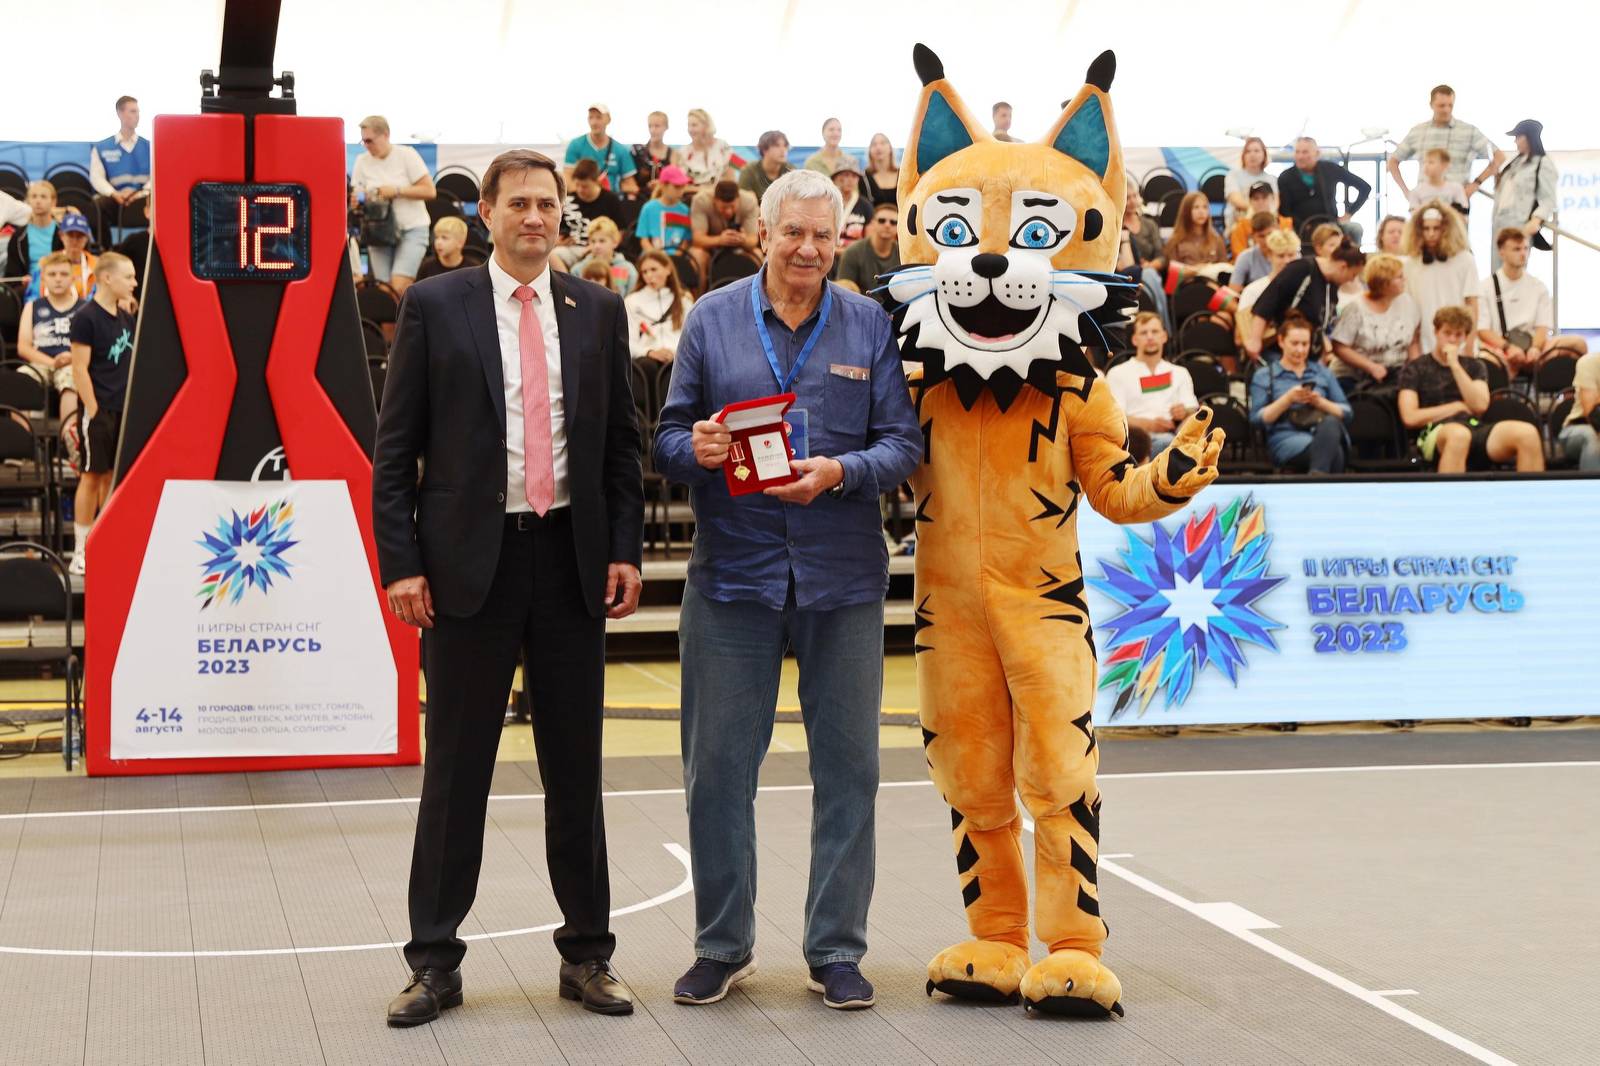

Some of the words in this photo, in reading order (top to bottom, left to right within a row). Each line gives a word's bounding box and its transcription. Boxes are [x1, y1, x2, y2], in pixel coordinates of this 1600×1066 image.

[240, 195, 294, 269] 12
[1302, 558, 1317, 577] II
[1321, 557, 1389, 577] ИГРЫ
[1393, 555, 1470, 577] СТРАН
[1471, 555, 1519, 576] СНГ
[1306, 581, 1525, 616] БЕЛАРУСЬ
[197, 623, 205, 633] II
[208, 623, 246, 633] ИГРЫ
[249, 622, 293, 633] СТРАН
[296, 622, 322, 633] СНГ
[197, 637, 322, 654] БЕЛАРУСЬ
[1312, 621, 1408, 654] 2023
[197, 658, 250, 675] 2023
[135, 706, 183, 724] 4-14
[135, 725, 184, 735] августа
